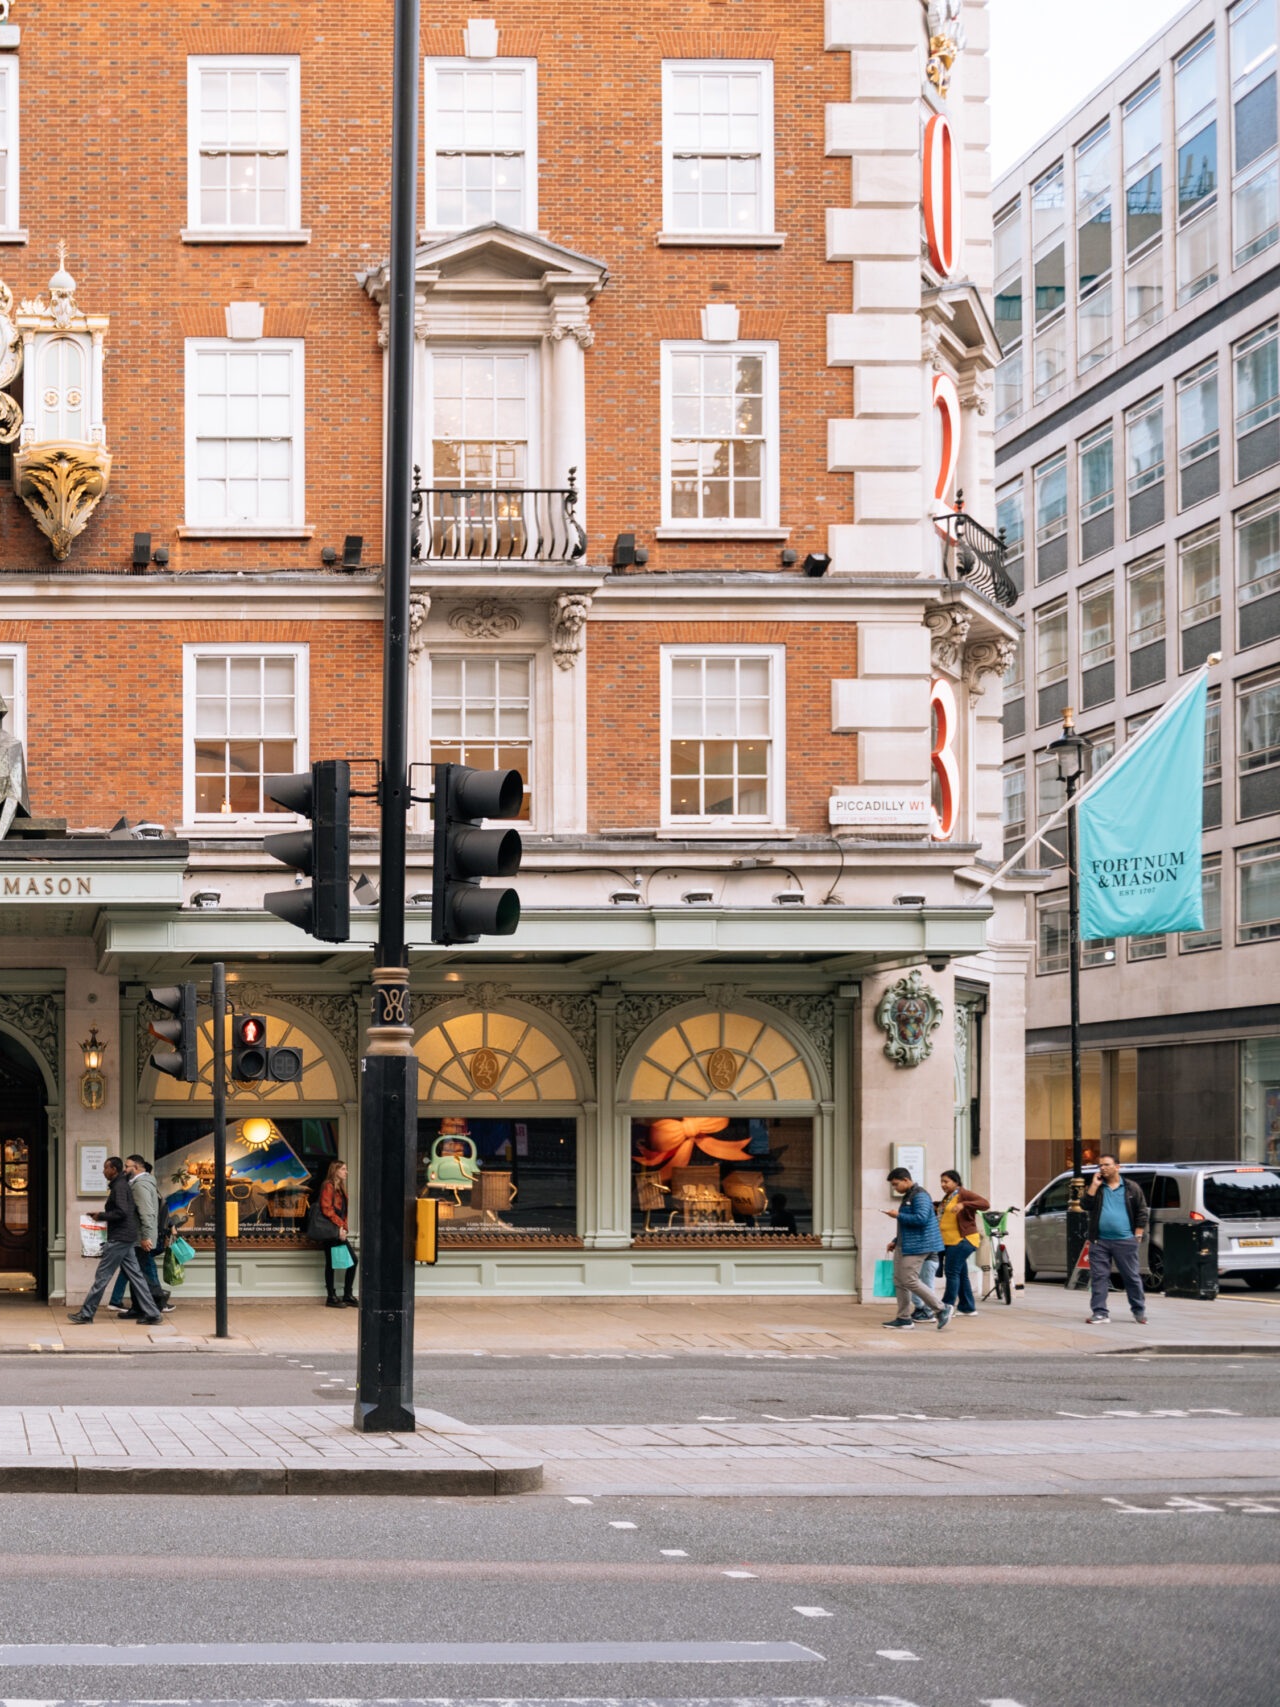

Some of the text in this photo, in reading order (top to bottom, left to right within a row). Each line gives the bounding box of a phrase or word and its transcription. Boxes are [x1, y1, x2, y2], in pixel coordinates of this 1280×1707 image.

[836, 801, 925, 811] PICCADILLY W1
[1092, 851, 1184, 874] FORTNUM
[4, 877, 92, 896] MASON
[1140, 887, 1156, 895] 1707
[688, 1208, 726, 1222] F&M
